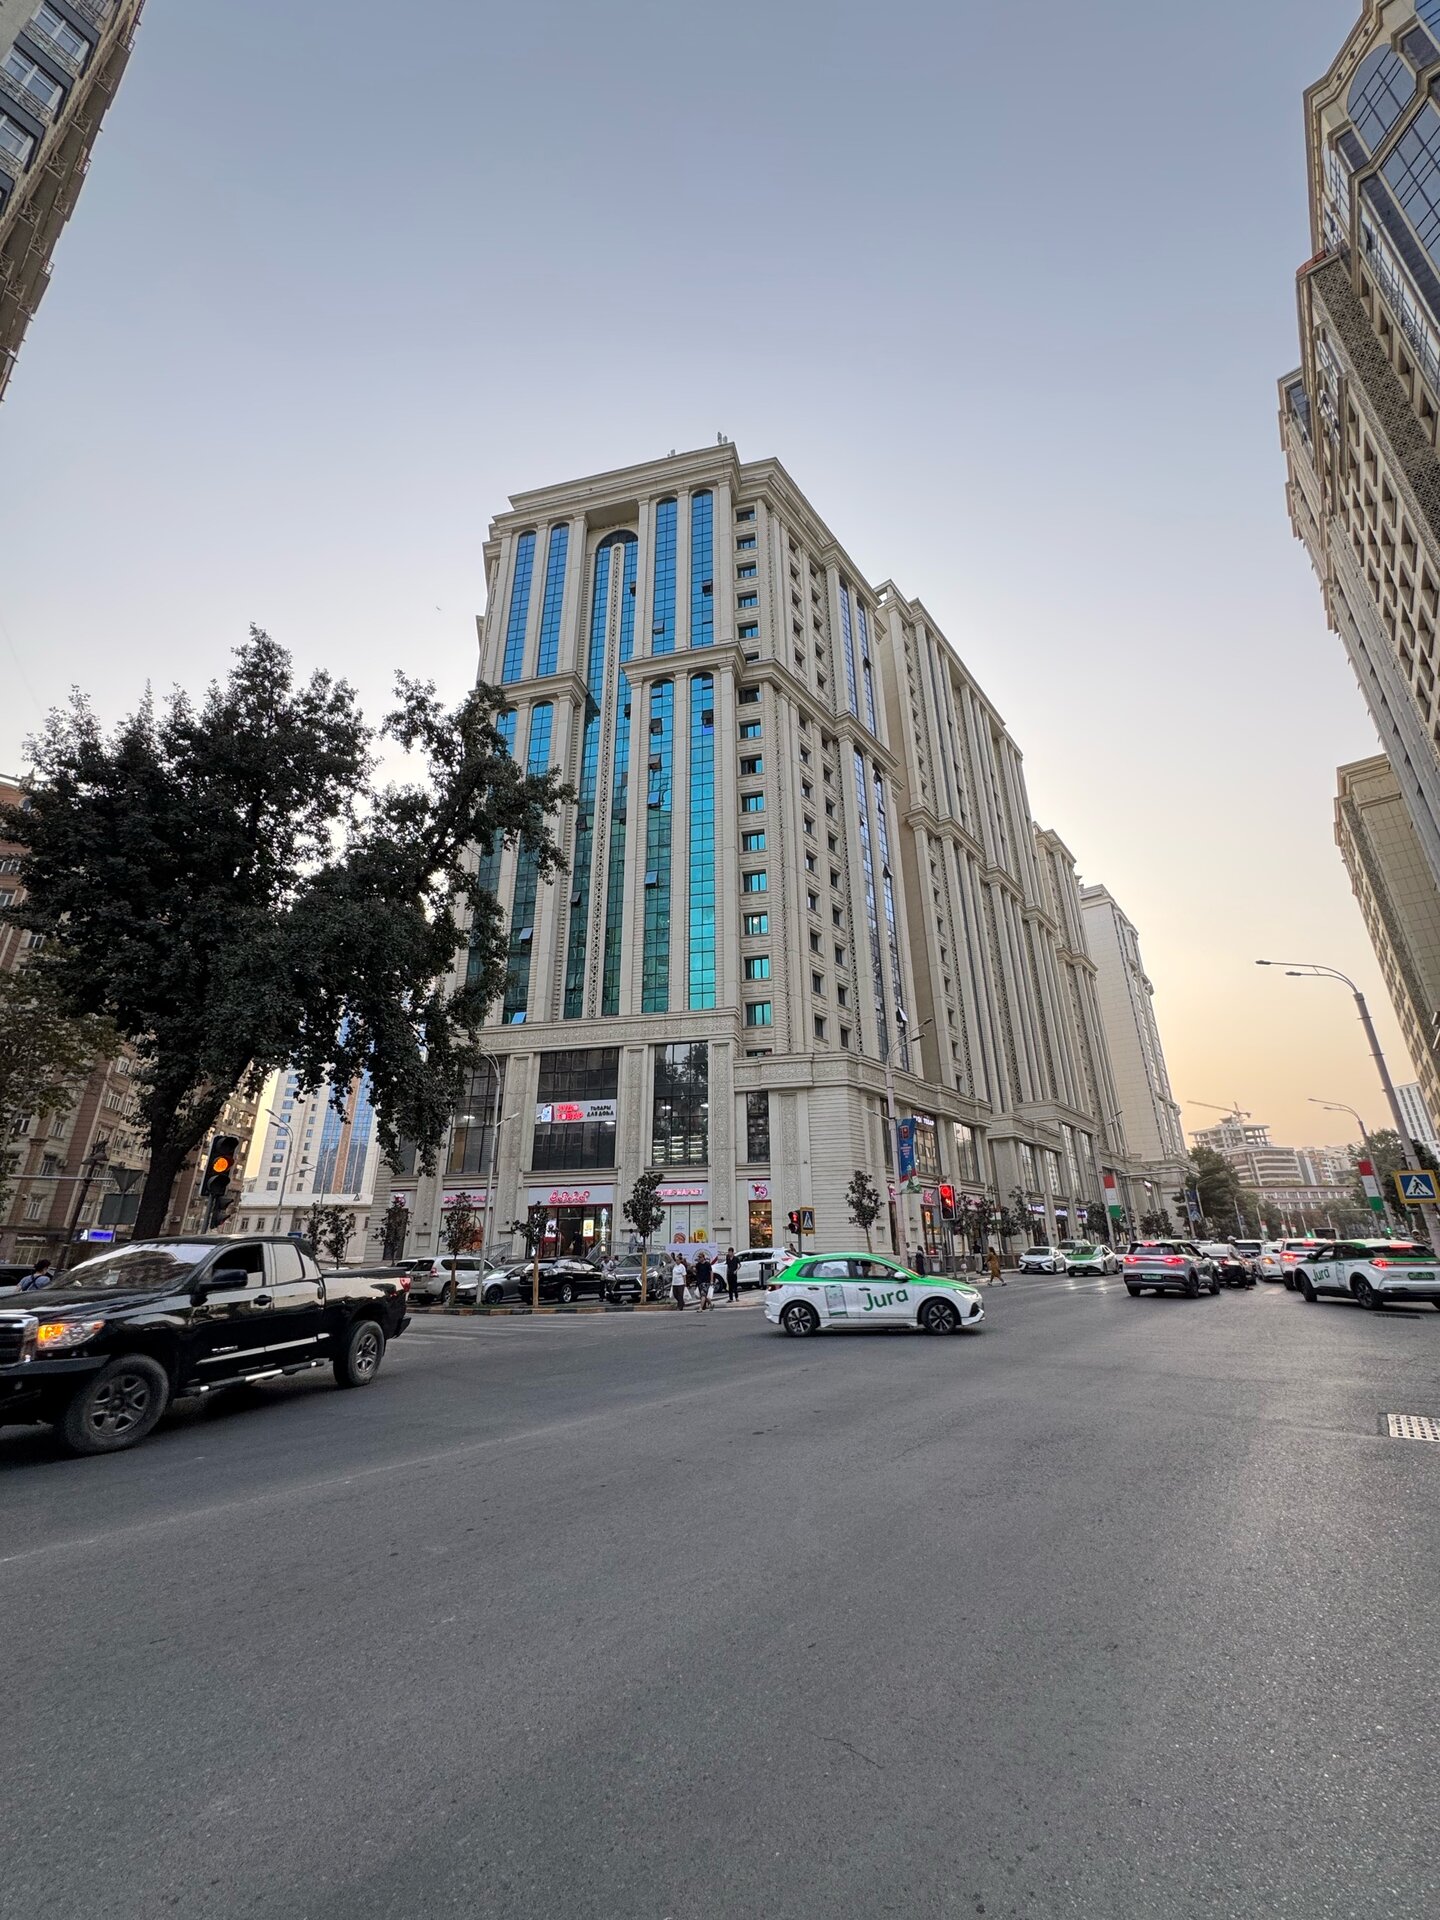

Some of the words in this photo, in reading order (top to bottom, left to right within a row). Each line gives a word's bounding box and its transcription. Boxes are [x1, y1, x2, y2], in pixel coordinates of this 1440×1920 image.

[557, 1104, 579, 1112] ЧУДО
[557, 1112, 584, 1120] ТОВАР
[1312, 1266, 1330, 1282] Jura
[863, 1288, 909, 1311] Jura
